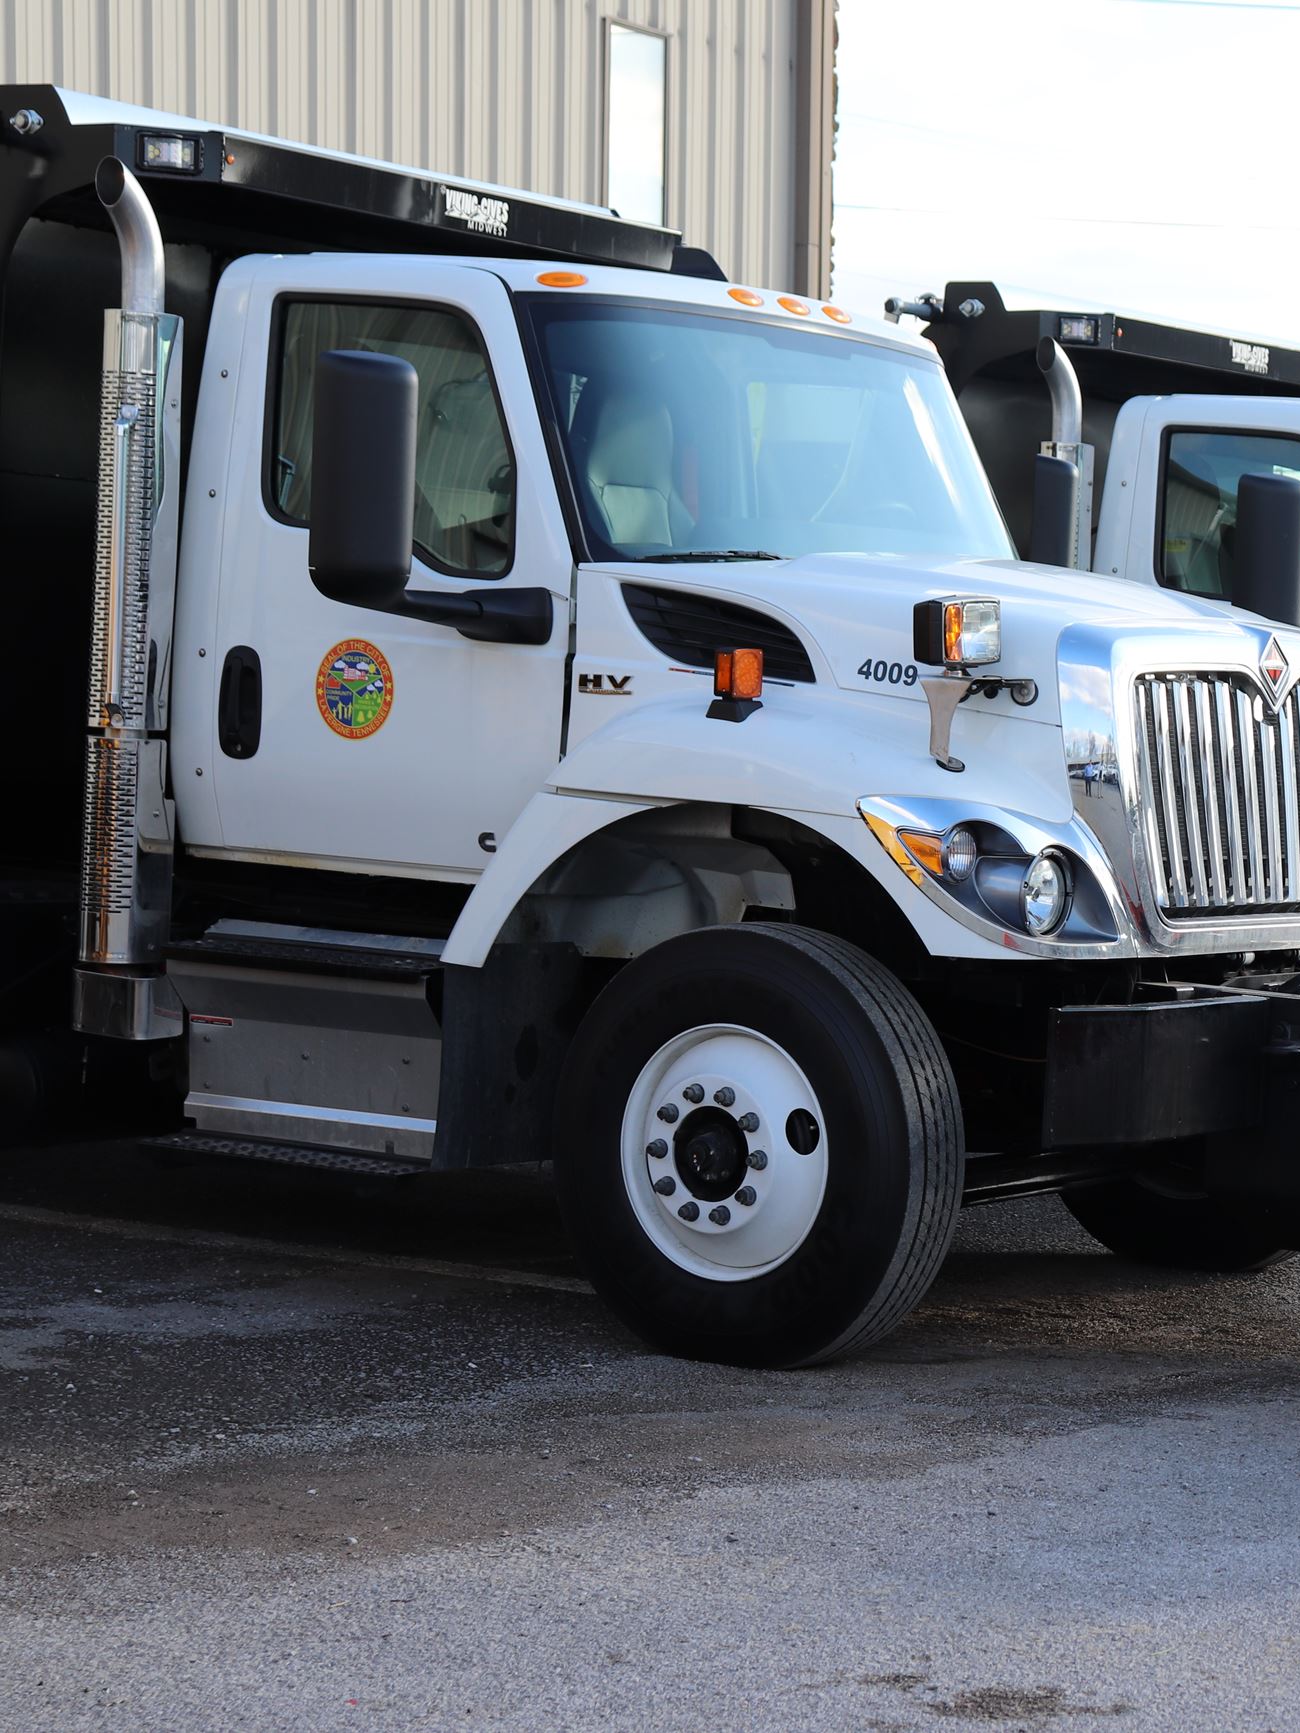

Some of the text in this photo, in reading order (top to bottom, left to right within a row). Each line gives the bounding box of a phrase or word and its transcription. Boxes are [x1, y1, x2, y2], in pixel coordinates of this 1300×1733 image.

[321, 651, 336, 672] SEAL
[336, 643, 346, 653] OF
[350, 641, 366, 651] THE
[366, 645, 384, 662] CITY
[578, 674, 634, 689] HV
[857, 658, 918, 687] 4009
